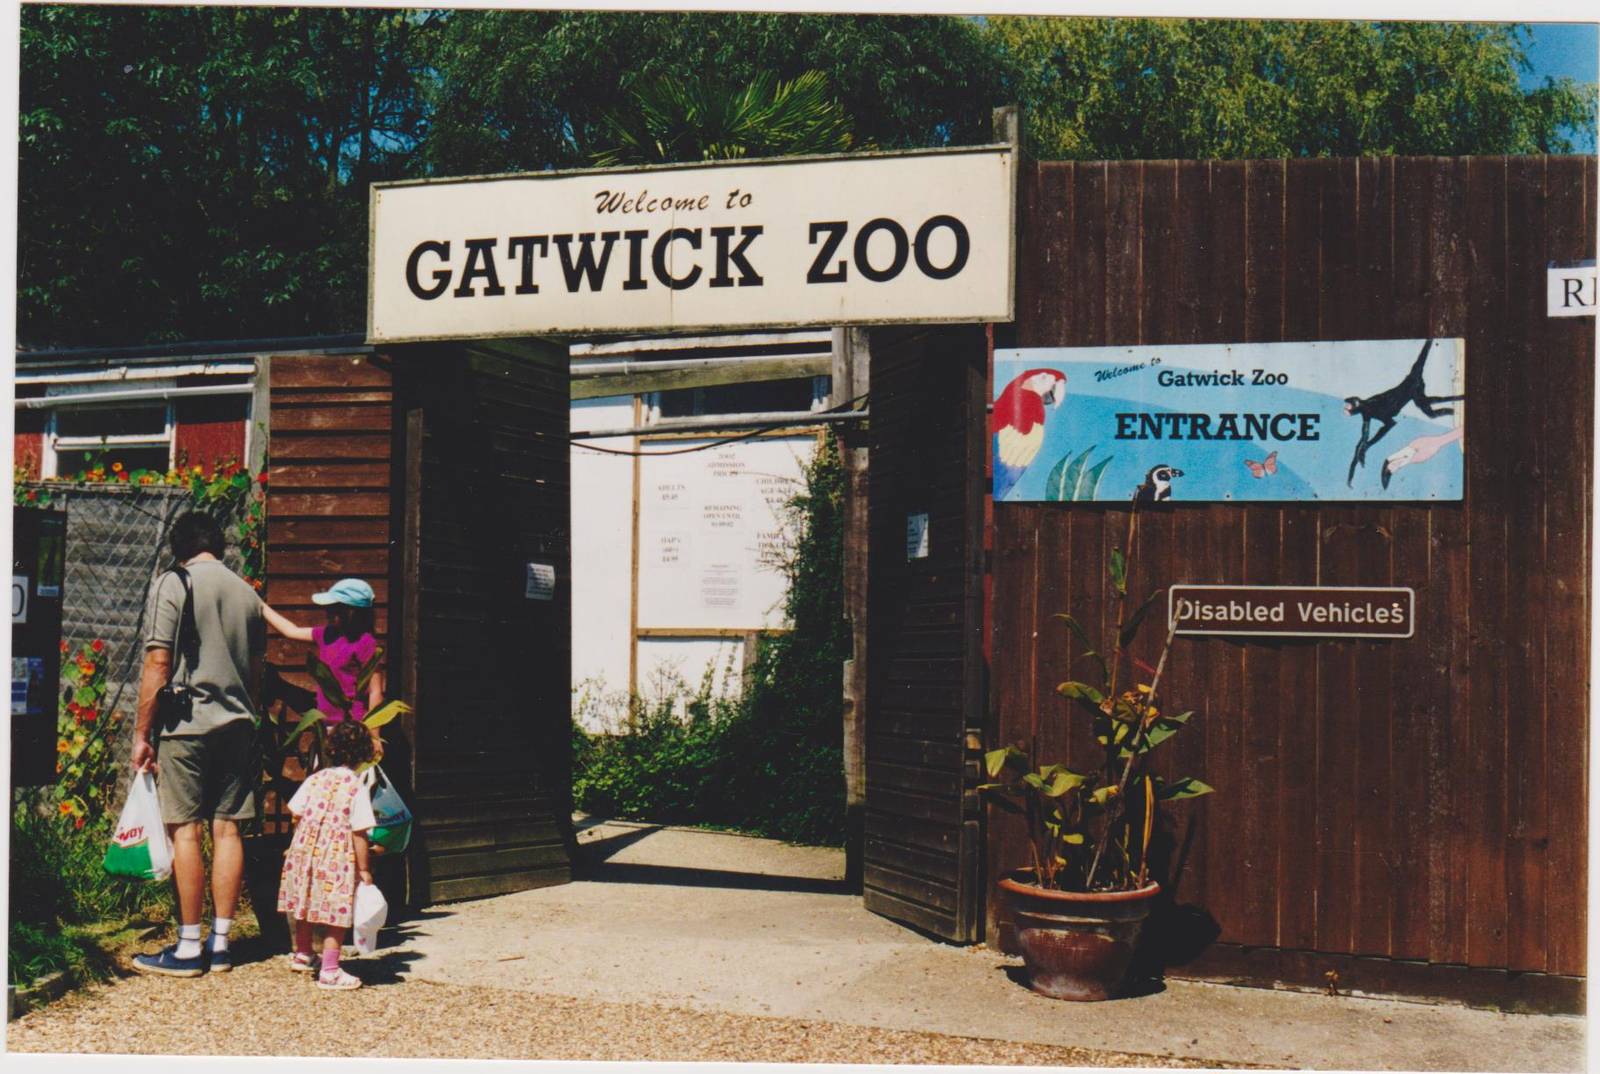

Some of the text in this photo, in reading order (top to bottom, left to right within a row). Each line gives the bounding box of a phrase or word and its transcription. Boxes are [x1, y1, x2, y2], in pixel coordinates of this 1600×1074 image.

[595, 188, 752, 214] Welcome to
[405, 214, 970, 301] GATWICK ZOO
[1562, 276, 1597, 308] R
[1095, 356, 1162, 383] Welcome to
[1157, 369, 1289, 387] Gatwick Zoo
[1114, 412, 1321, 441] ENTRANCE
[1176, 600, 1405, 624] Disabled Vehicles
